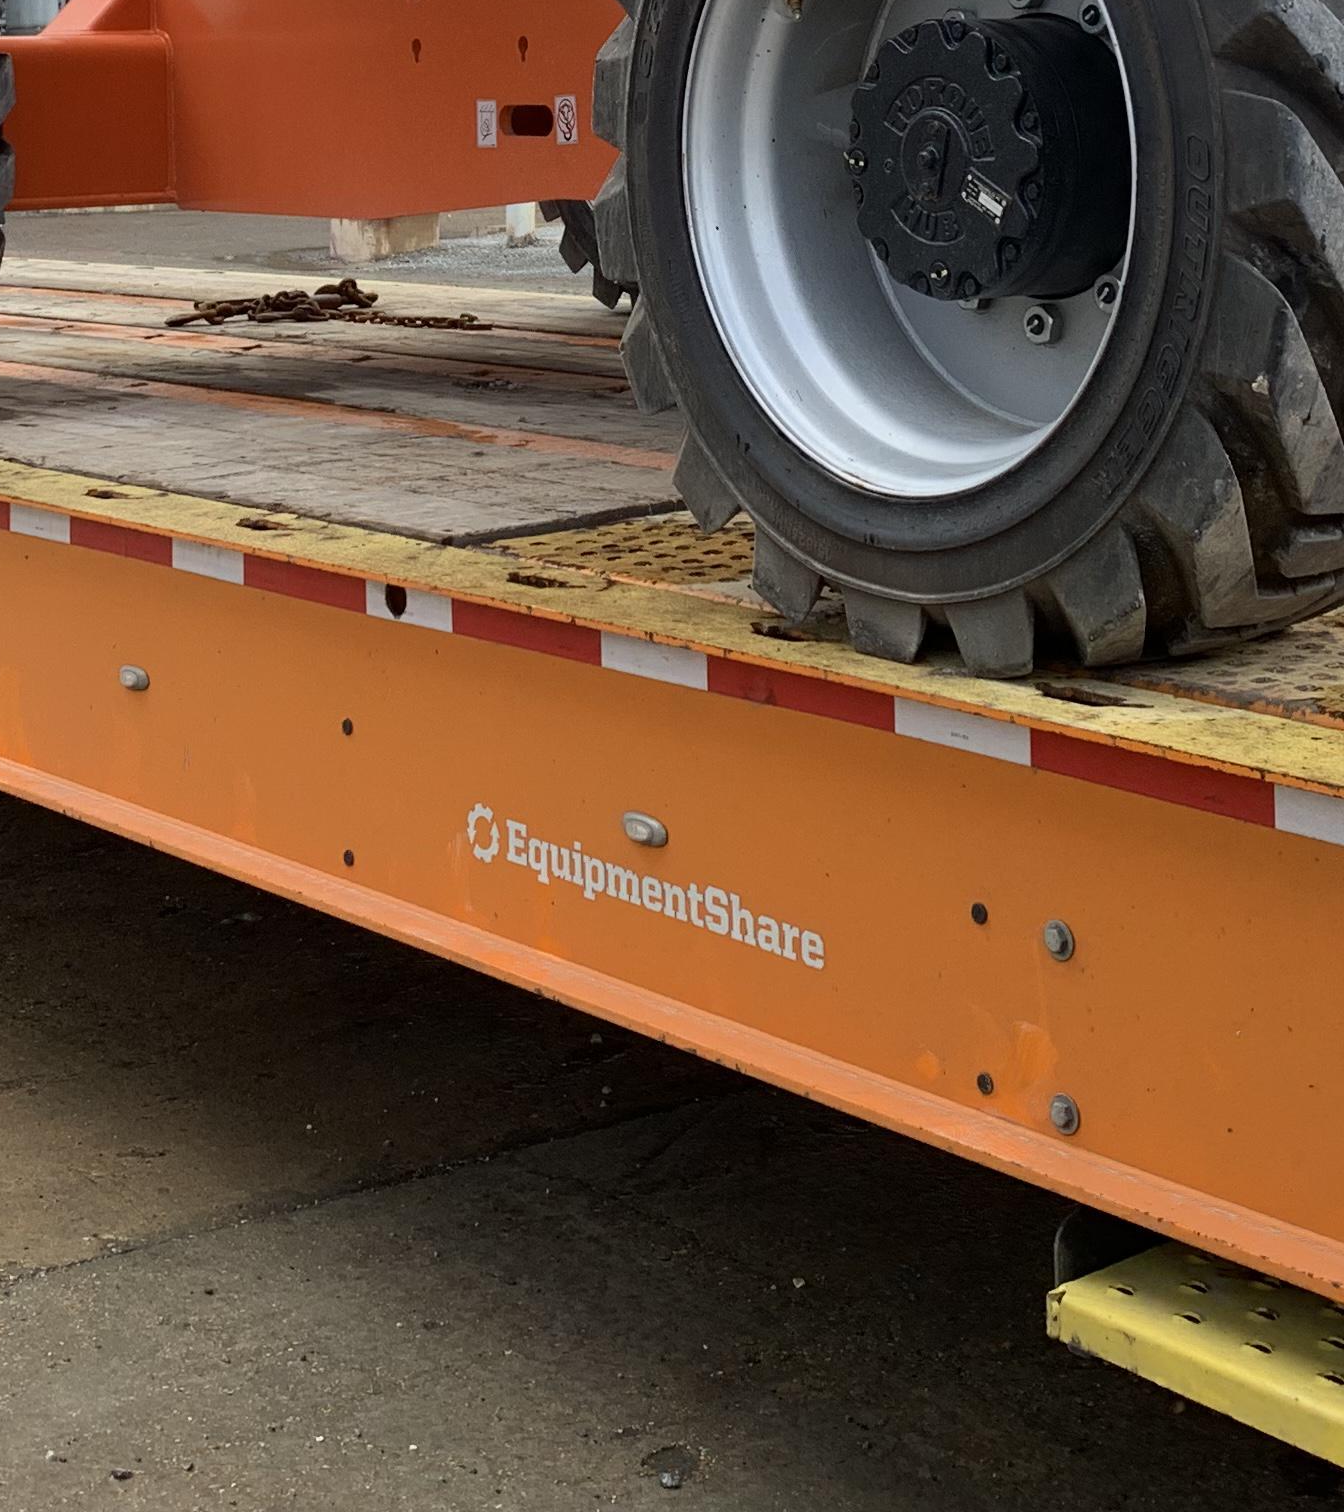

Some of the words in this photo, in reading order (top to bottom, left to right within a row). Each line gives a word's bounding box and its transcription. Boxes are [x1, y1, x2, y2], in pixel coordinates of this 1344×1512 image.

[884, 76, 996, 161] TORQUE
[892, 196, 966, 245] HUB
[506, 818, 825, 970] EquipmentShare
